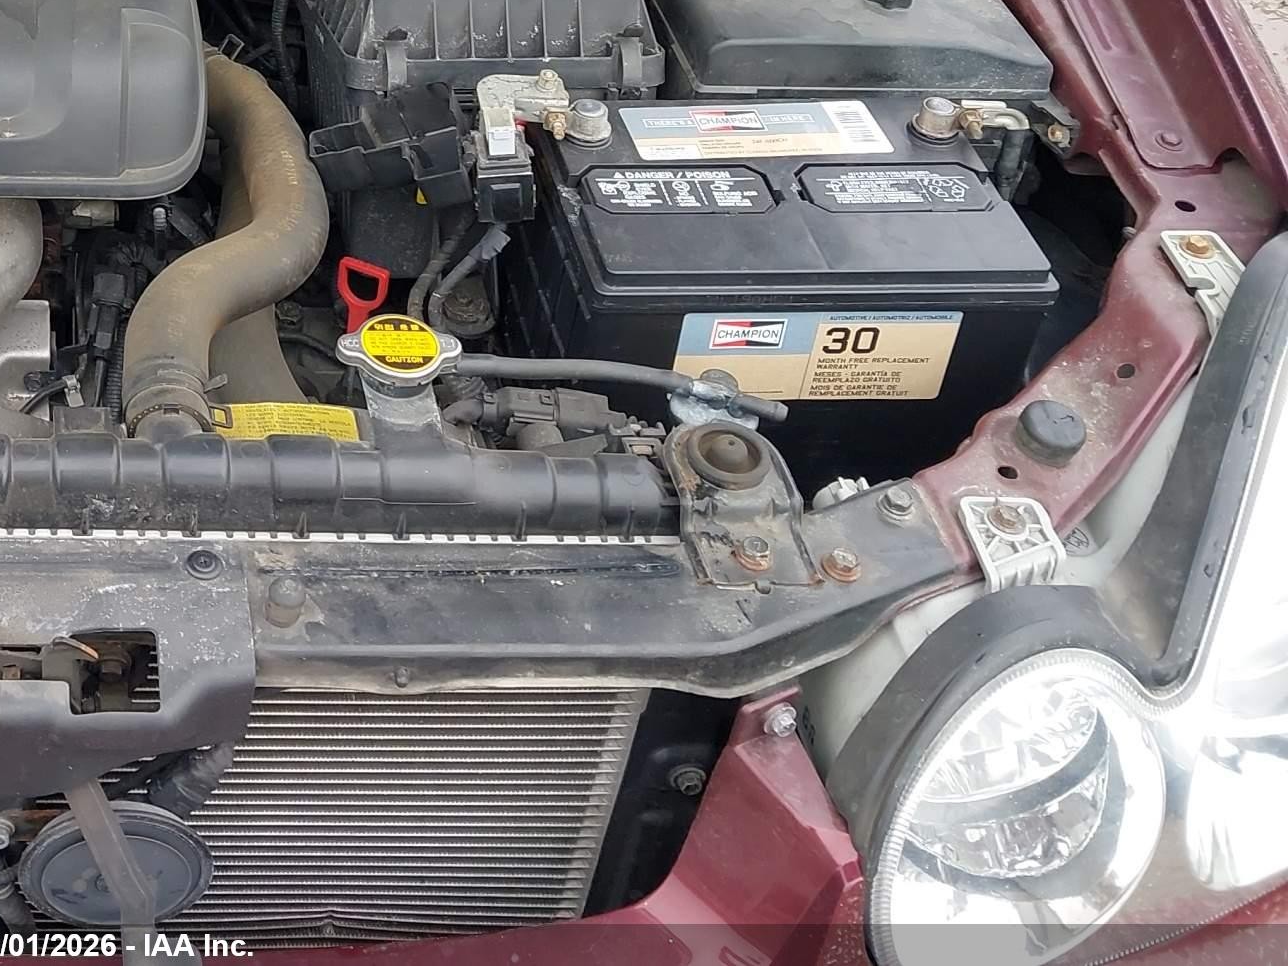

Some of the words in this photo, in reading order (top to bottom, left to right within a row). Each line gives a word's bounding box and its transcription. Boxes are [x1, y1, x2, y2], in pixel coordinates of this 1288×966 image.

[698, 112, 759, 126] CHAMPION
[624, 171, 674, 179] DANGER
[685, 171, 731, 179] POISON
[717, 329, 779, 339] CHAMPION
[821, 327, 880, 355] 30
